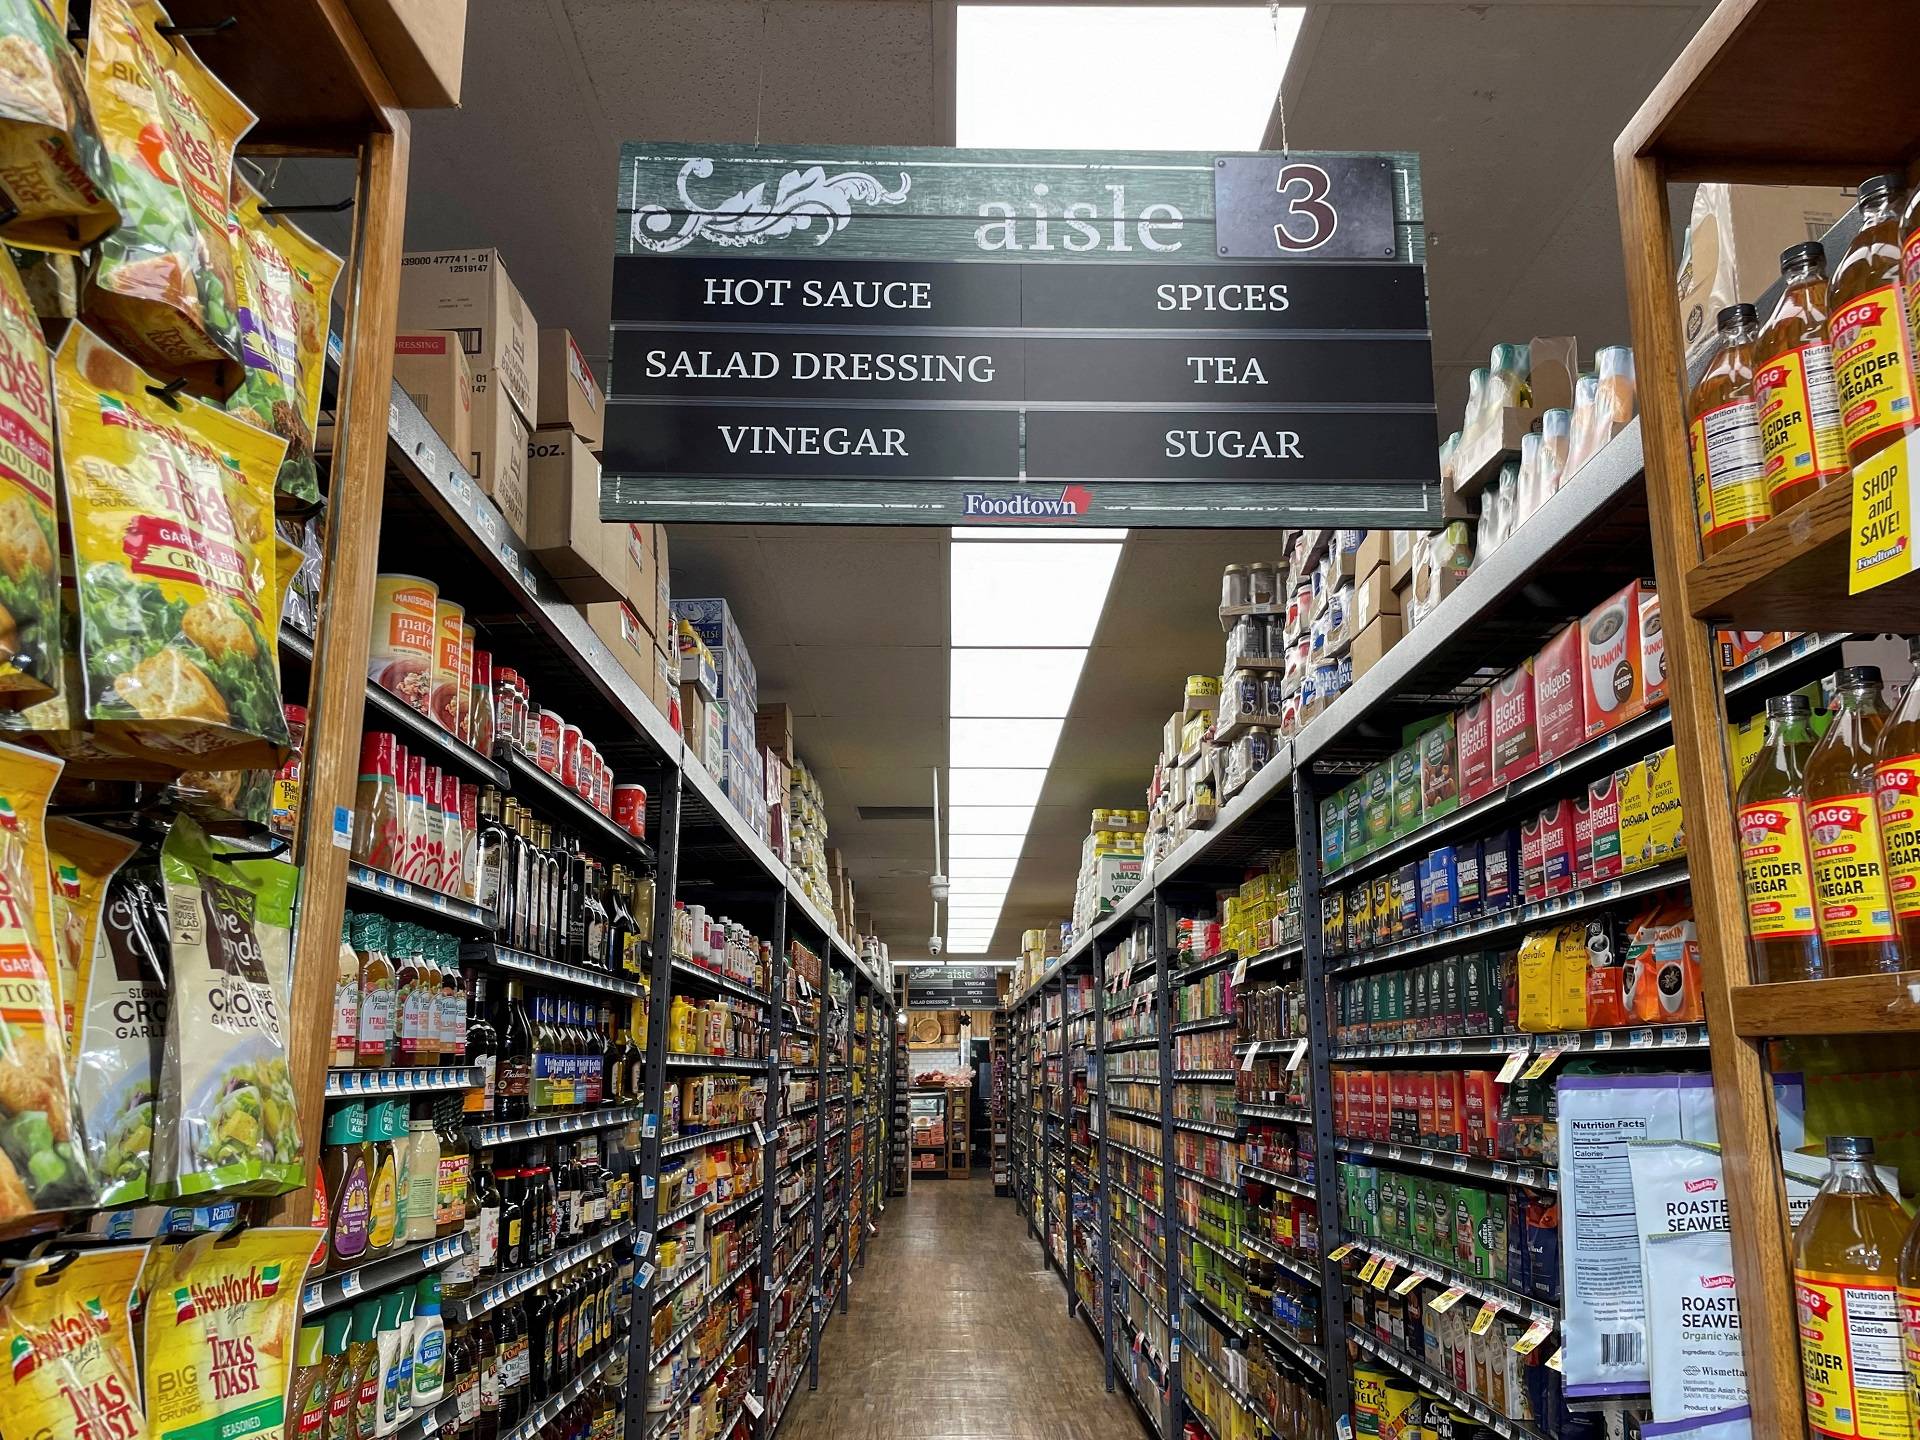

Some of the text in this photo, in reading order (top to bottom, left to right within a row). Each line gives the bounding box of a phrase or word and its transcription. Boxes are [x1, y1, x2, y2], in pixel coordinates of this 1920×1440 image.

[974, 184, 1185, 252] aisle
[1273, 163, 1338, 252] 3
[434, 255, 460, 264] 47774
[478, 254, 488, 263] 01
[450, 265, 487, 273] 12519147
[704, 278, 932, 309] HOT SAUCE
[1156, 284, 1290, 311] SPICES
[645, 350, 996, 383] SALAD DRESSING
[1187, 357, 1268, 385] TEA
[1854, 351, 1900, 378] CIDER
[476, 375, 487, 383] 01
[1705, 408, 1737, 423] Nutrition
[1767, 411, 1802, 436] CIDER
[718, 425, 909, 456] VINEGAR
[1165, 430, 1304, 459] SUGAR
[1707, 434, 1735, 448] Calories
[1862, 465, 1897, 501] SHOP
[965, 493, 1077, 516] Foodtown
[1868, 490, 1892, 520] and
[1860, 511, 1900, 547] SAVE!
[1857, 544, 1903, 571] Foodtown
[1540, 669, 1572, 701] Folgers
[1617, 680, 1630, 691] BLEND
[1496, 695, 1522, 727] EIGHT
[1541, 699, 1574, 728] Classic Roast
[1461, 721, 1485, 750] EIGHT
[1496, 714, 1522, 737] O'CLOCK
[1461, 740, 1484, 760] O'CLOCK
[1592, 804, 1613, 820] EIGHT
[1651, 797, 1682, 816] COLOMBIA
[1621, 811, 1649, 829] COLOMBIA
[1543, 828, 1562, 848] EIGHT
[1760, 862, 1803, 878] CIDER
[1834, 862, 1880, 880] CIDER
[947, 967, 971, 979] aisle
[1573, 1120, 1645, 1129] Nutrition Facts
[213, 1206, 235, 1221] Ranch
[1847, 1290, 1890, 1300] Nutrition
[1682, 1332, 1721, 1341] Organic
[1850, 1325, 1888, 1335] Calories
[207, 1335, 256, 1371] TEXAS
[424, 1347, 442, 1359] Ranch
[1809, 1353, 1843, 1371] CIDER
[157, 1365, 198, 1394] BIG
[209, 1363, 260, 1400] TOAST
[222, 1416, 261, 1438] SEASONED
